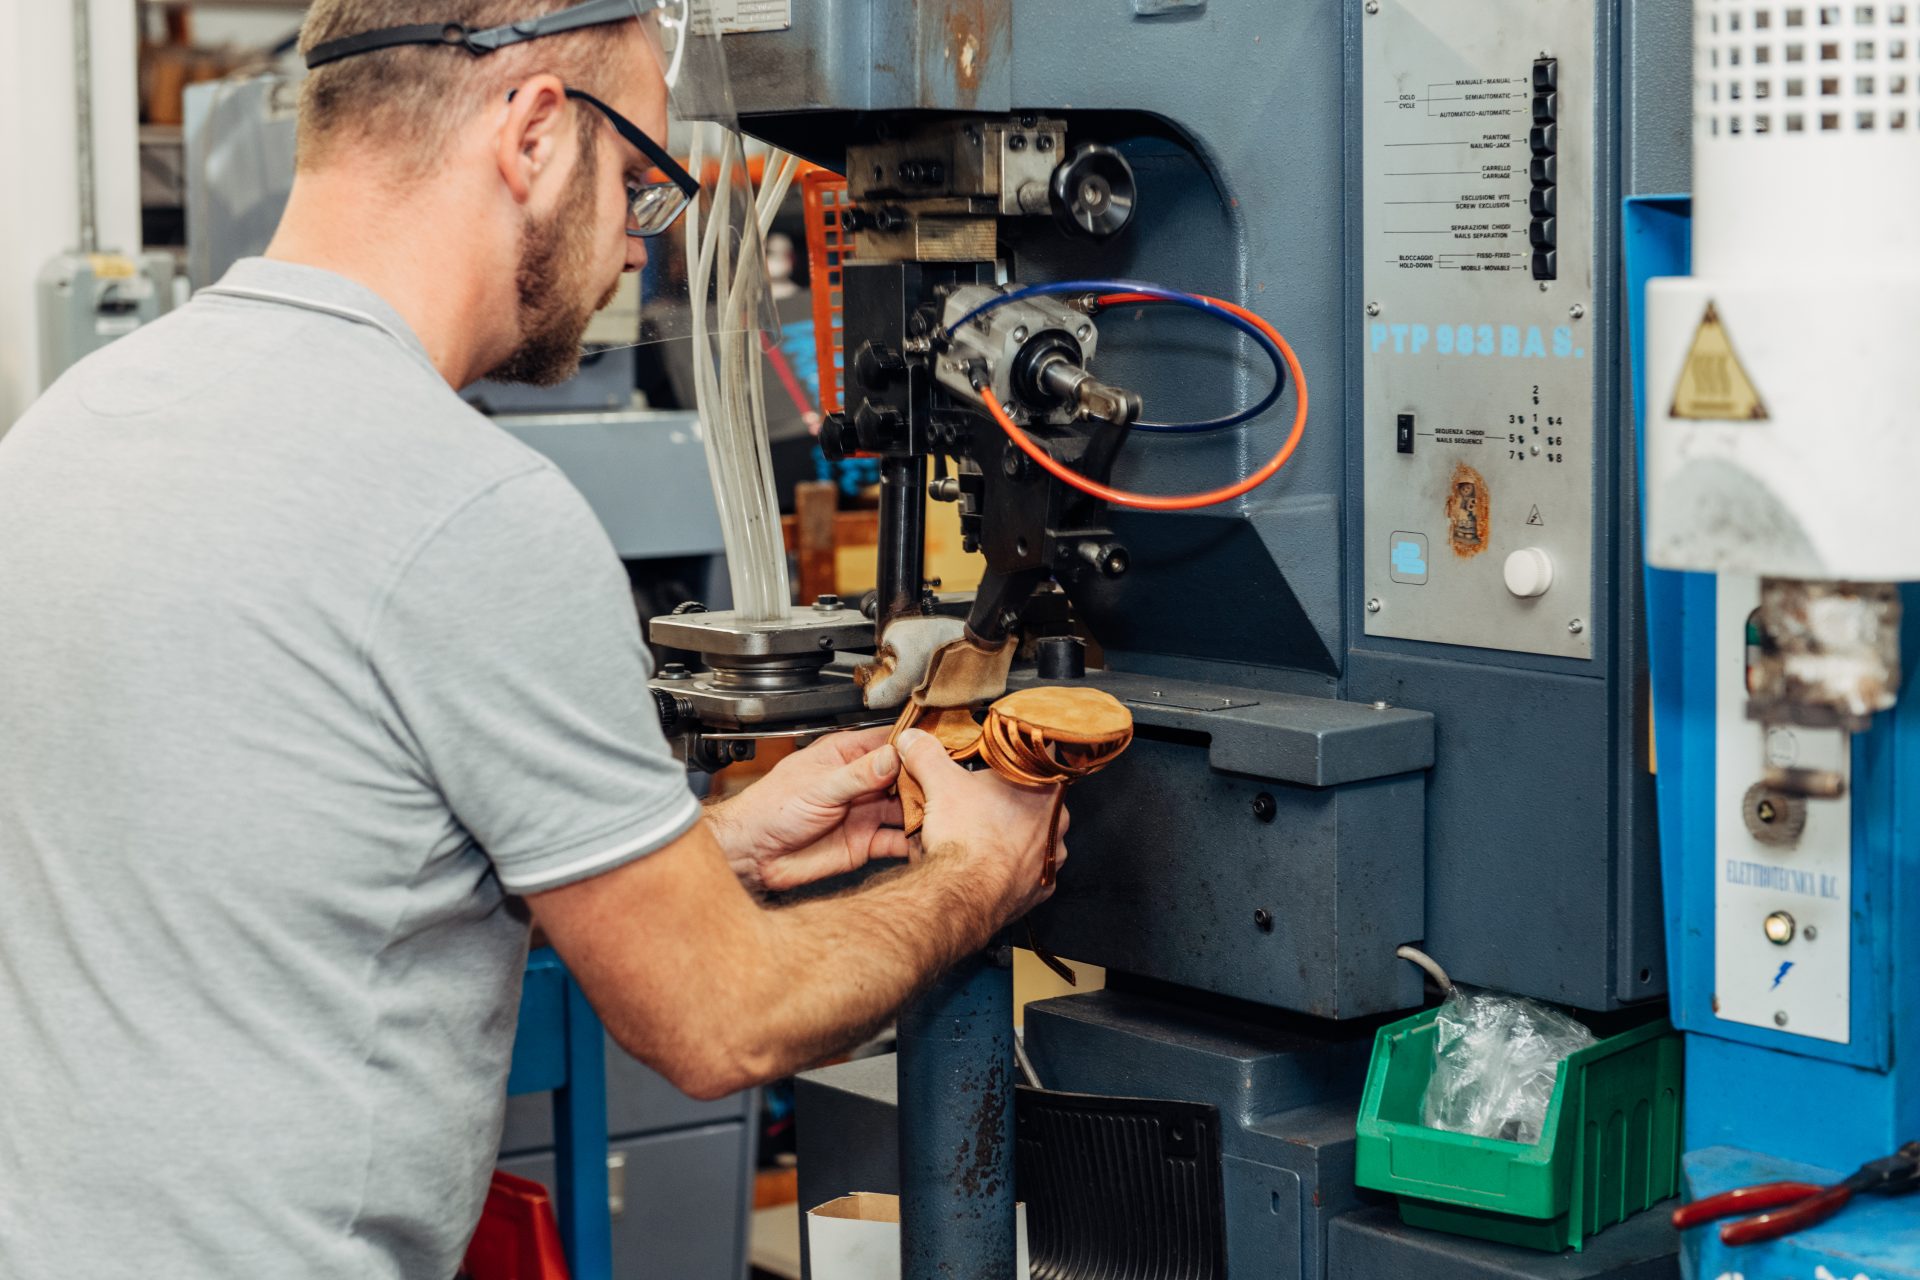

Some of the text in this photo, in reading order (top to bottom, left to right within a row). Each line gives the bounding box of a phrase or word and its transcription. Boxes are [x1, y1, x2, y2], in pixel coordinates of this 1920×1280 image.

[1455, 78, 1511, 86] MANUALE-MANUAL
[1439, 109, 1511, 118] AUTOMATICO-AUTOMATIC
[1370, 322, 1430, 354] PTP
[1532, 385, 1539, 395] 2
[1508, 414, 1516, 424] 3
[1555, 416, 1563, 426] 4
[1454, 437, 1483, 445] SEQUENCE
[1508, 433, 1516, 443] 5
[1555, 436, 1563, 446] 6
[1508, 450, 1516, 459] 7
[1555, 453, 1563, 463] 8
